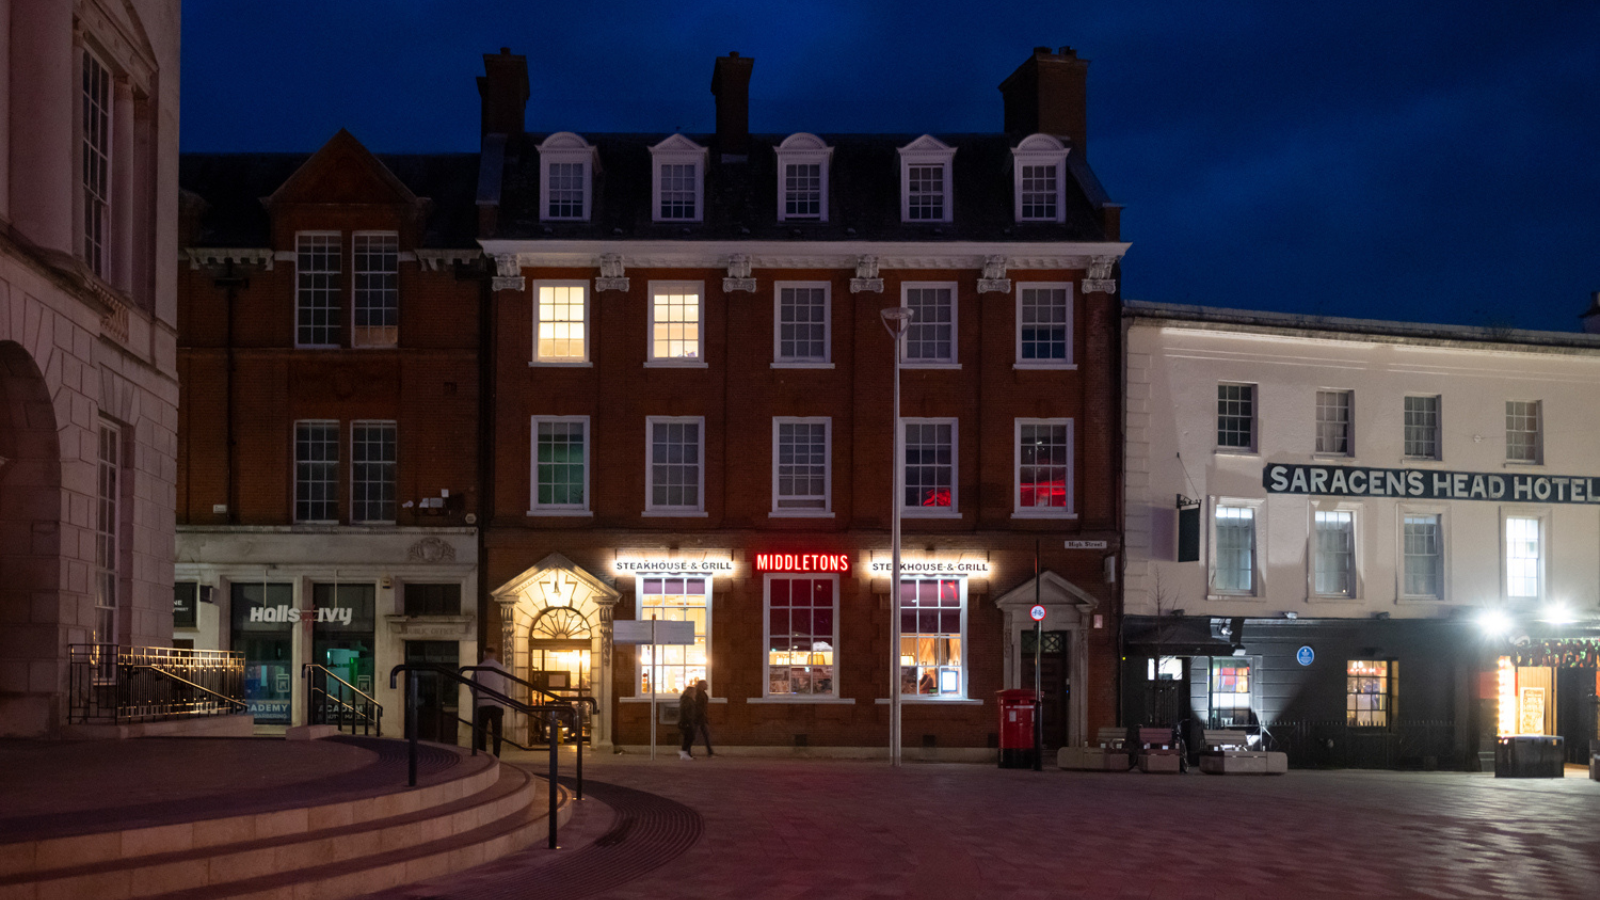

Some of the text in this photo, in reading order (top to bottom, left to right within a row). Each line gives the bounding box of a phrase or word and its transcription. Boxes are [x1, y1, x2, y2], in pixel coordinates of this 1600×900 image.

[1269, 466, 1600, 502] SARACEN'S HEAD HOTEL
[616, 562, 732, 570] STEAKHOUSE & GRILL
[757, 554, 848, 571] MIDDLETONS
[872, 563, 989, 571] STEKHOUSE & GRILL
[249, 604, 301, 623] Halls
[317, 607, 353, 626] Ivy
